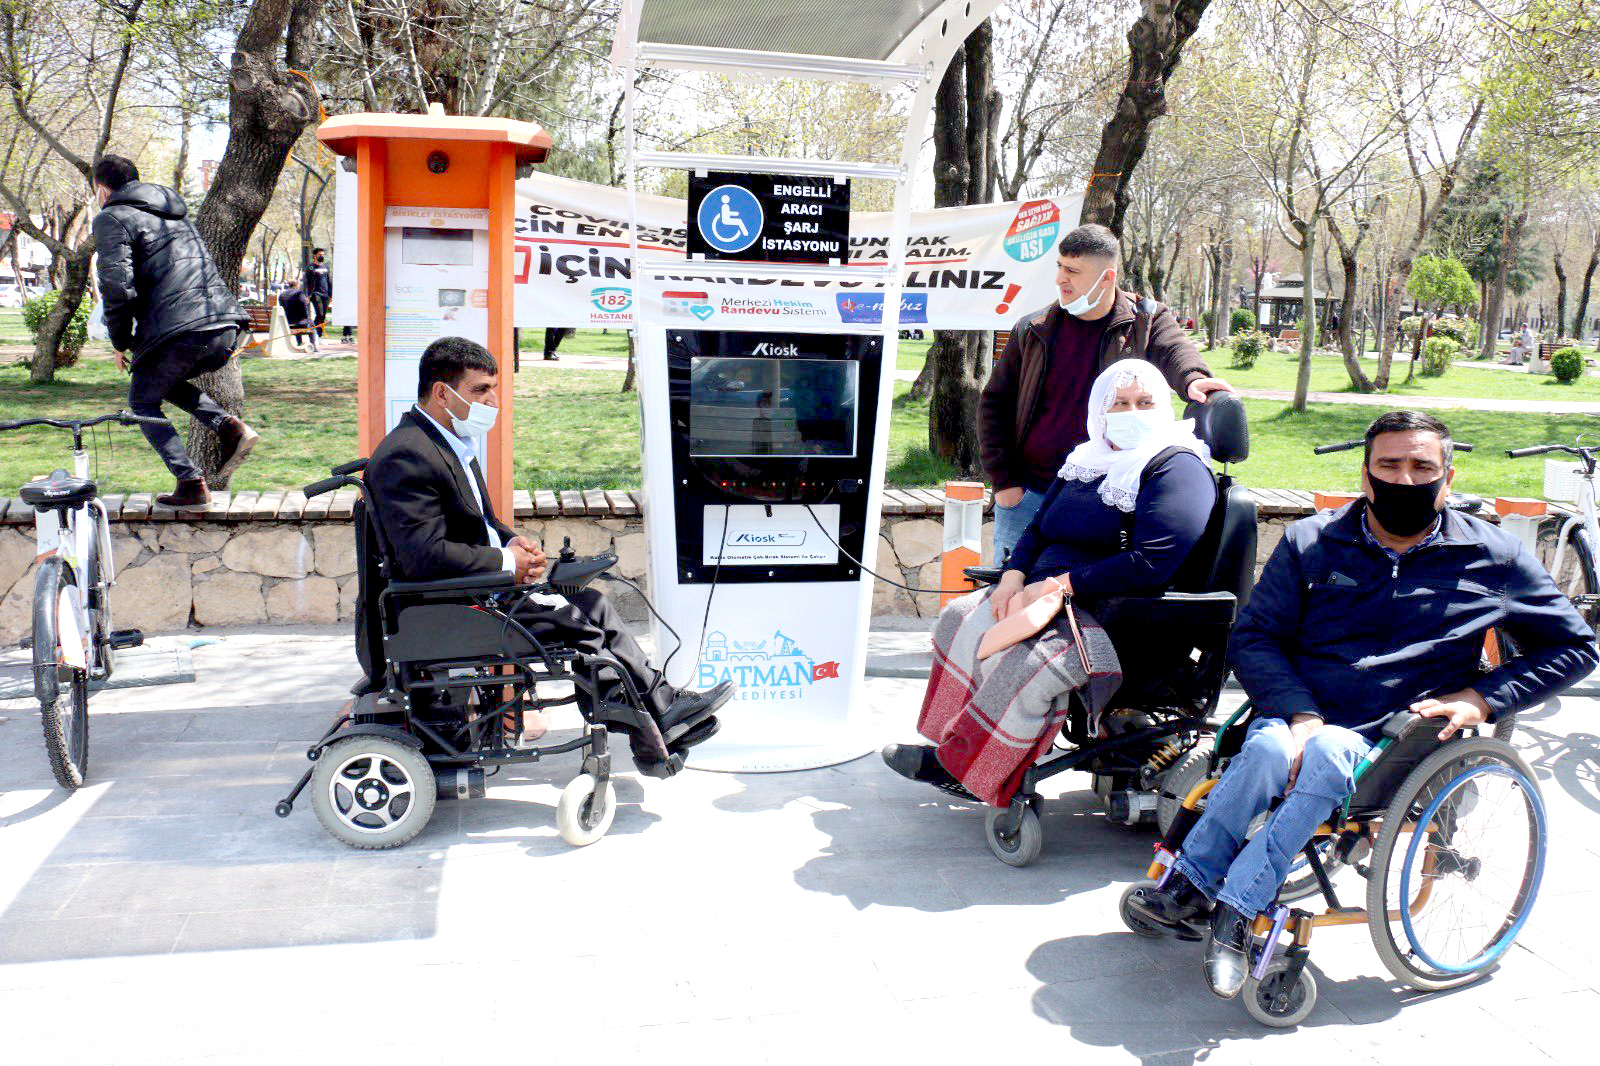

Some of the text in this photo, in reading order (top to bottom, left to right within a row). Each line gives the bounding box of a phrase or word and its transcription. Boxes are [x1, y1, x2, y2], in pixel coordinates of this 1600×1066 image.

[774, 184, 832, 198] ENGELLİ
[781, 203, 823, 215] ARACI
[783, 221, 819, 235] ŞARJ
[515, 214, 565, 235] ÇİN
[576, 222, 624, 238] EN
[637, 232, 687, 248] ÖN
[869, 247, 972, 259] AALIM.
[762, 236, 840, 252] İSTASYONU
[538, 244, 632, 284] İÇİN
[599, 295, 626, 306] 182
[721, 298, 813, 308] Merkezi Hekim
[720, 306, 827, 316] Randevu Sistemi
[751, 342, 799, 356] Kiosk
[735, 533, 776, 543] Kiosk
[697, 661, 816, 688] BATMAN
[732, 688, 802, 701] LEDİYESİ
